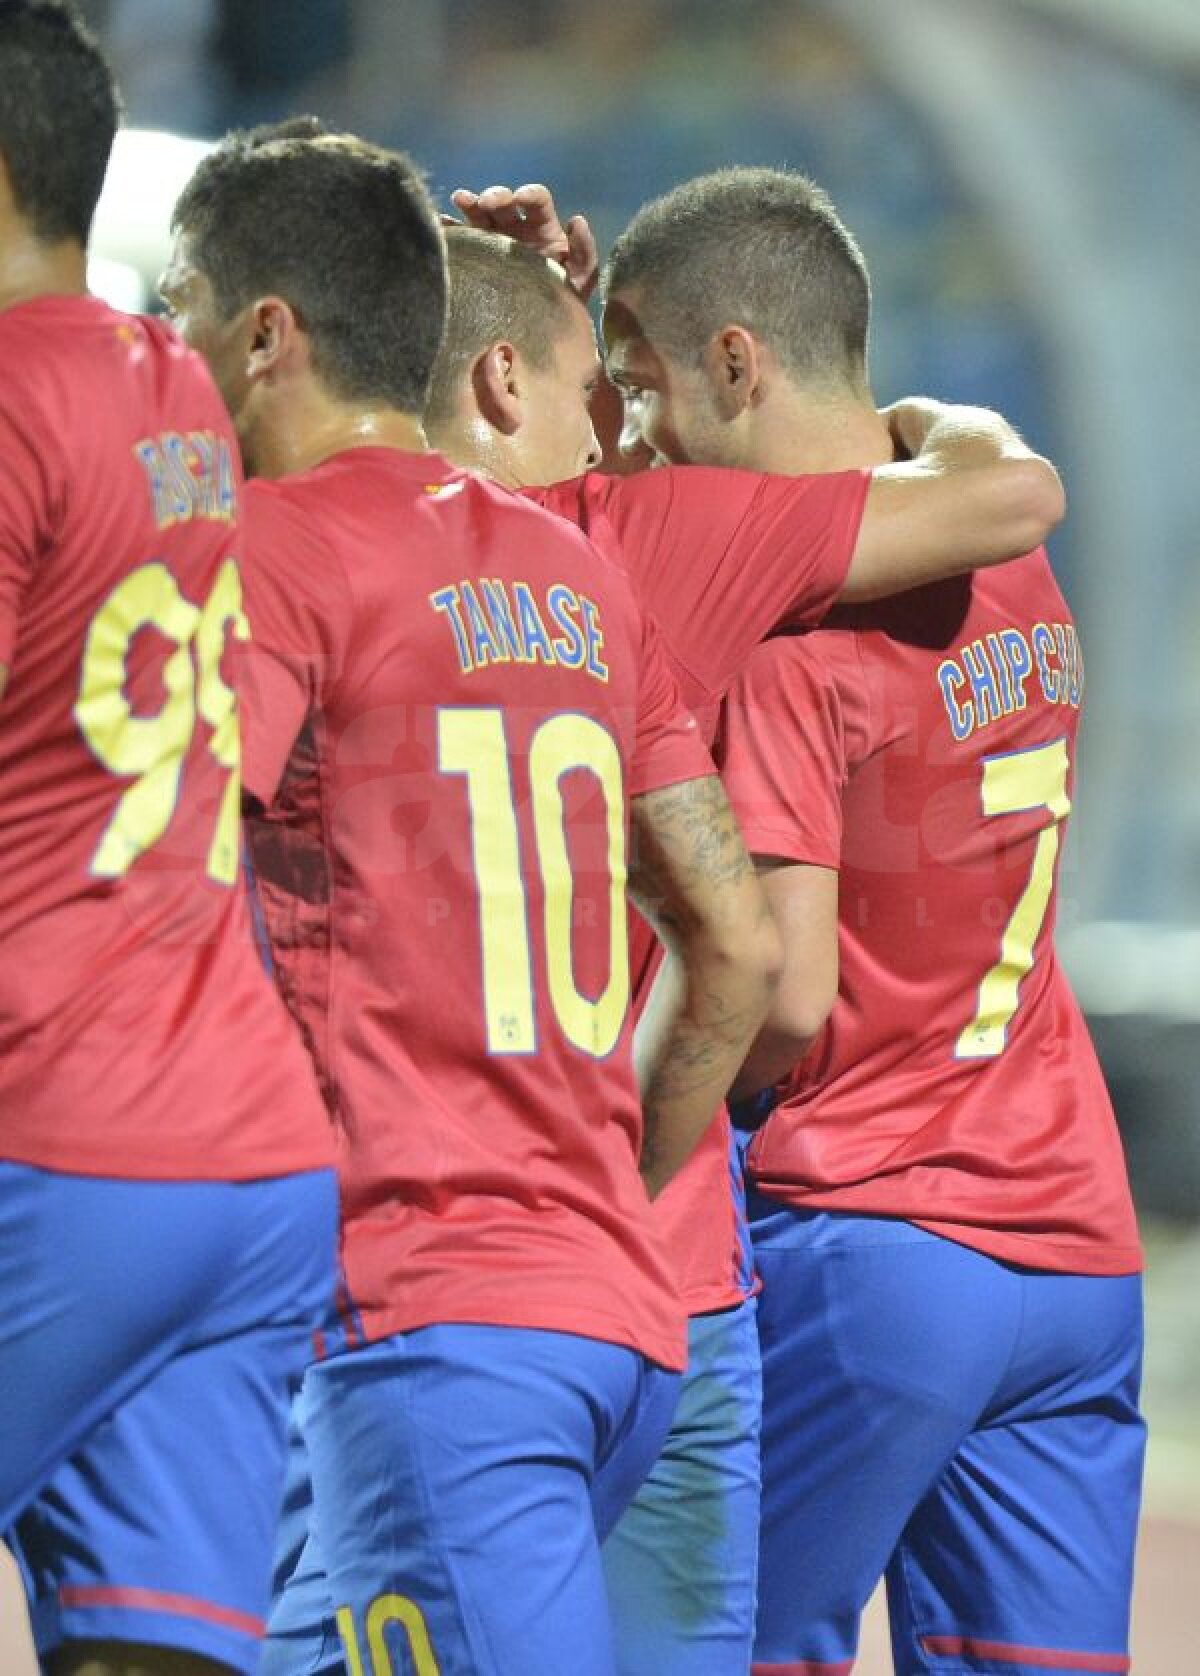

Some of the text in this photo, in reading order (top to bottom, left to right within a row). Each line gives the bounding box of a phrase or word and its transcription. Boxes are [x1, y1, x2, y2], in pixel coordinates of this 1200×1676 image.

[429, 577, 609, 684] TANASE
[436, 704, 631, 1061] 10
[953, 736, 1072, 1060] 7
